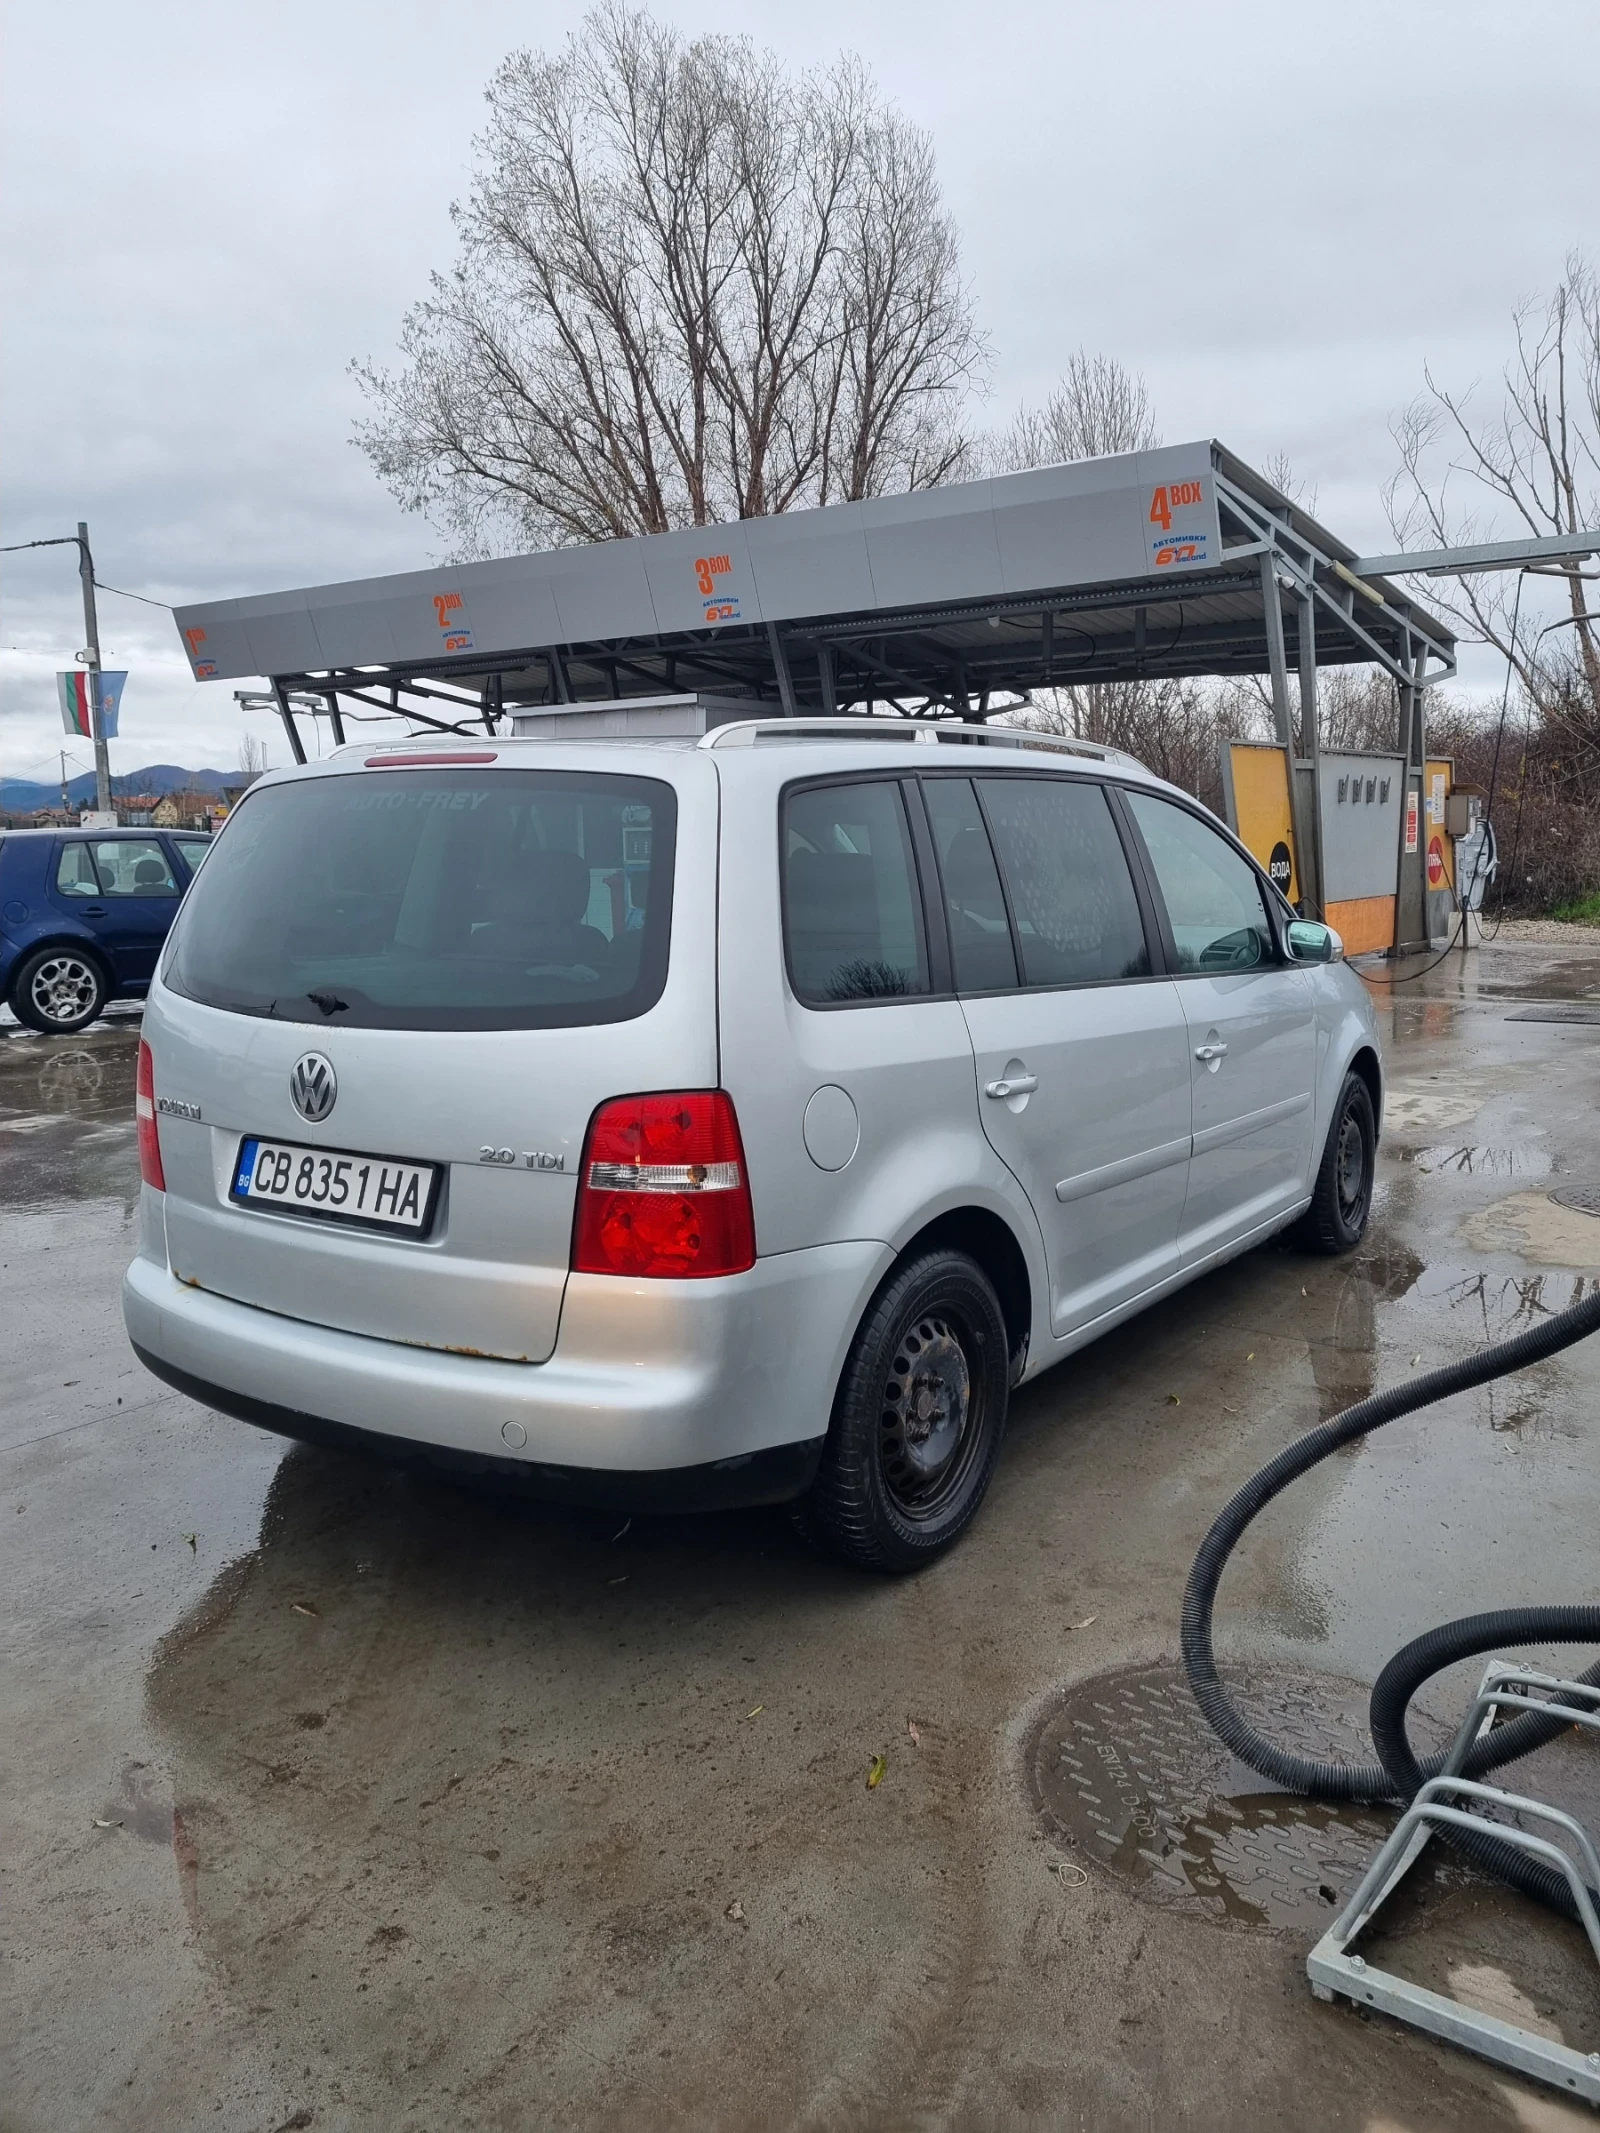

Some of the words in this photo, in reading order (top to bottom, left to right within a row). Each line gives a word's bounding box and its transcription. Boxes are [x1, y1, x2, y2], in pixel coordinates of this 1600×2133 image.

[1150, 486, 1172, 530] 4
[1170, 481, 1202, 506] BOX
[1153, 535, 1207, 549] АВТОМИВКИ
[1175, 552, 1206, 563] second
[695, 558, 714, 595] 3
[709, 555, 732, 574] BOX
[433, 595, 451, 627] 2
[444, 593, 463, 609] BOX
[1428, 853, 1442, 867] ПЯНА
[1271, 861, 1290, 880] ВОДА
[522, 1151, 564, 1171] TDI
[238, 1174, 250, 1188] BG
